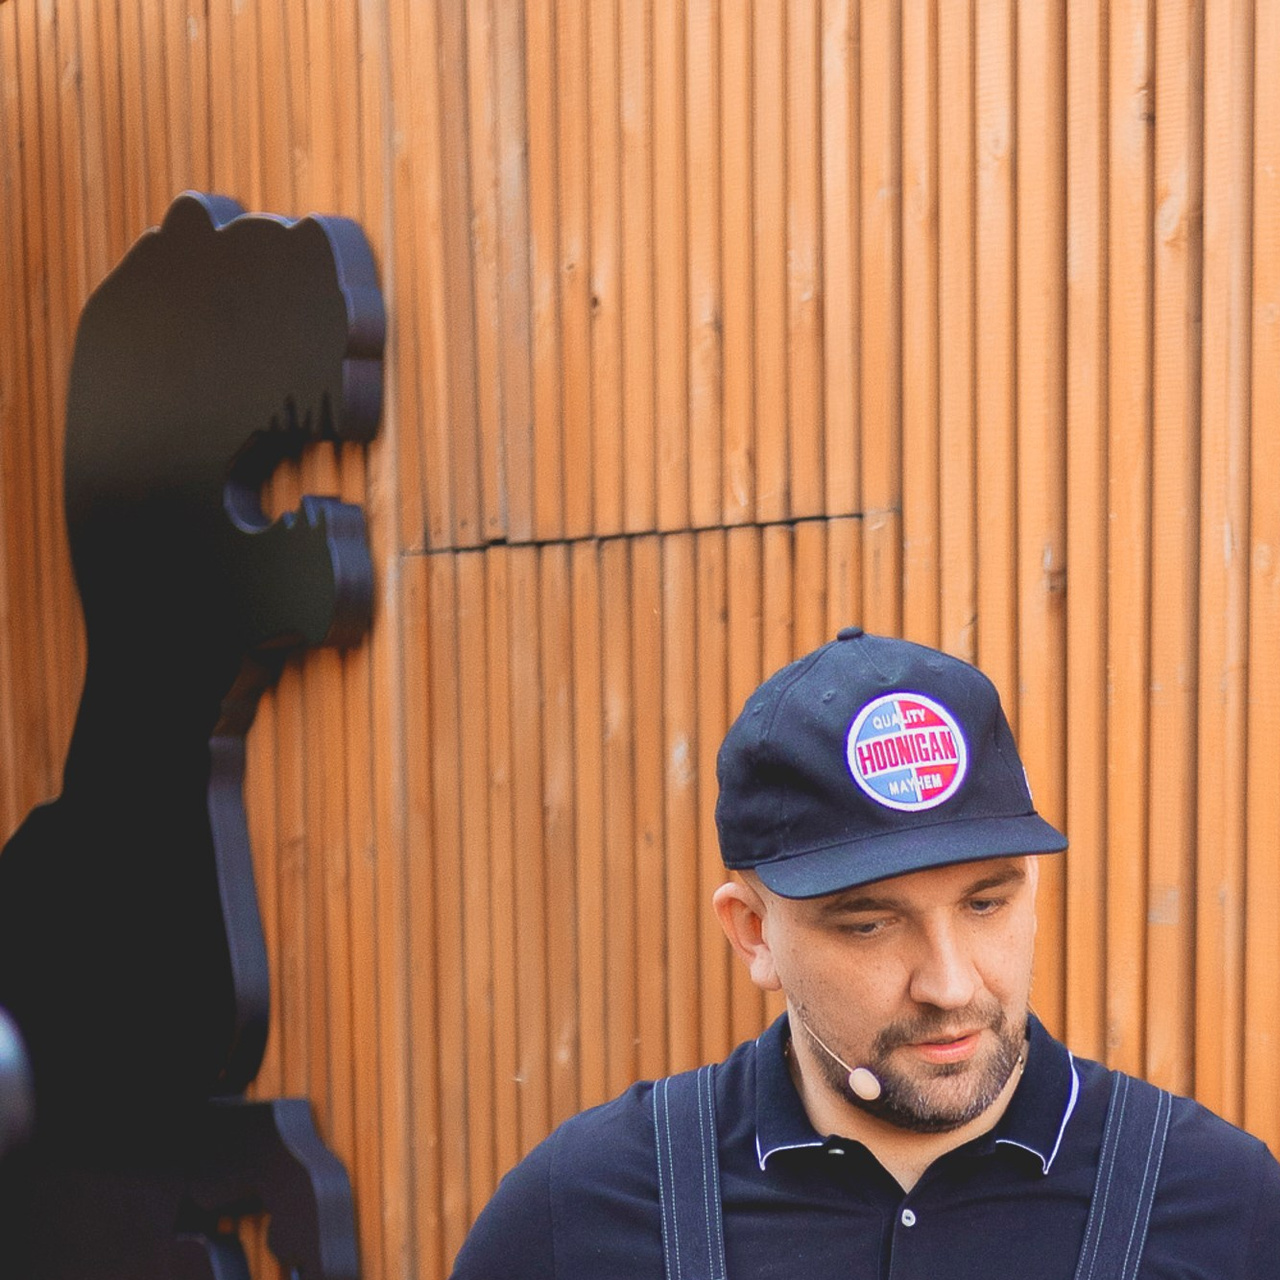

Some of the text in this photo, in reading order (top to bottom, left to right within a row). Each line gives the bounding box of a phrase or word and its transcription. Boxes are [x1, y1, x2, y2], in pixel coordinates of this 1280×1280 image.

[873, 710, 926, 730] QUALITY
[857, 731, 957, 776] HOONIGAN
[889, 774, 943, 796] MAYHEM
